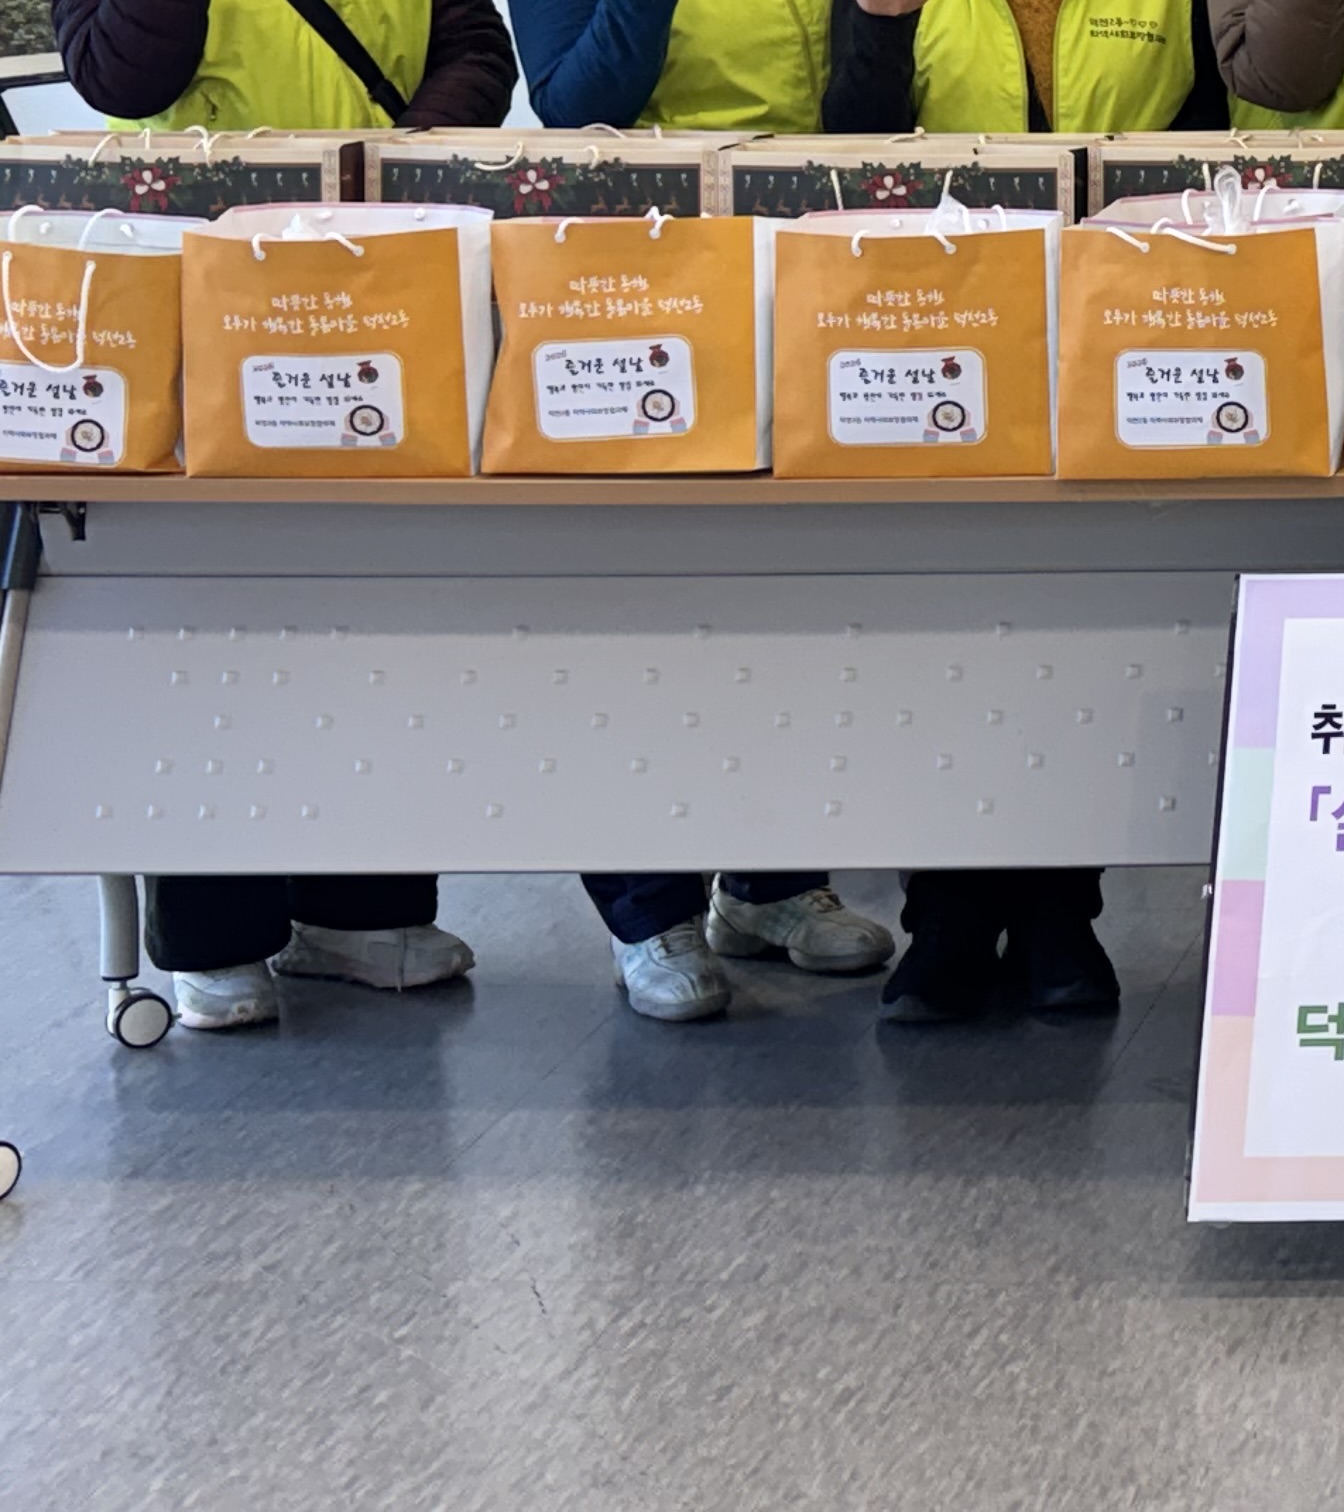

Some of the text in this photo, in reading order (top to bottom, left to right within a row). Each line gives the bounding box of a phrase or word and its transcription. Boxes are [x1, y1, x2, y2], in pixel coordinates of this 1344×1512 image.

[564, 357, 643, 376] 즐거운 설날
[1146, 367, 1219, 383] 즐거운 설날
[272, 372, 352, 389] 즐거운 설날
[859, 367, 935, 384] 즐거운 설날
[45, 382, 77, 400] 설날
